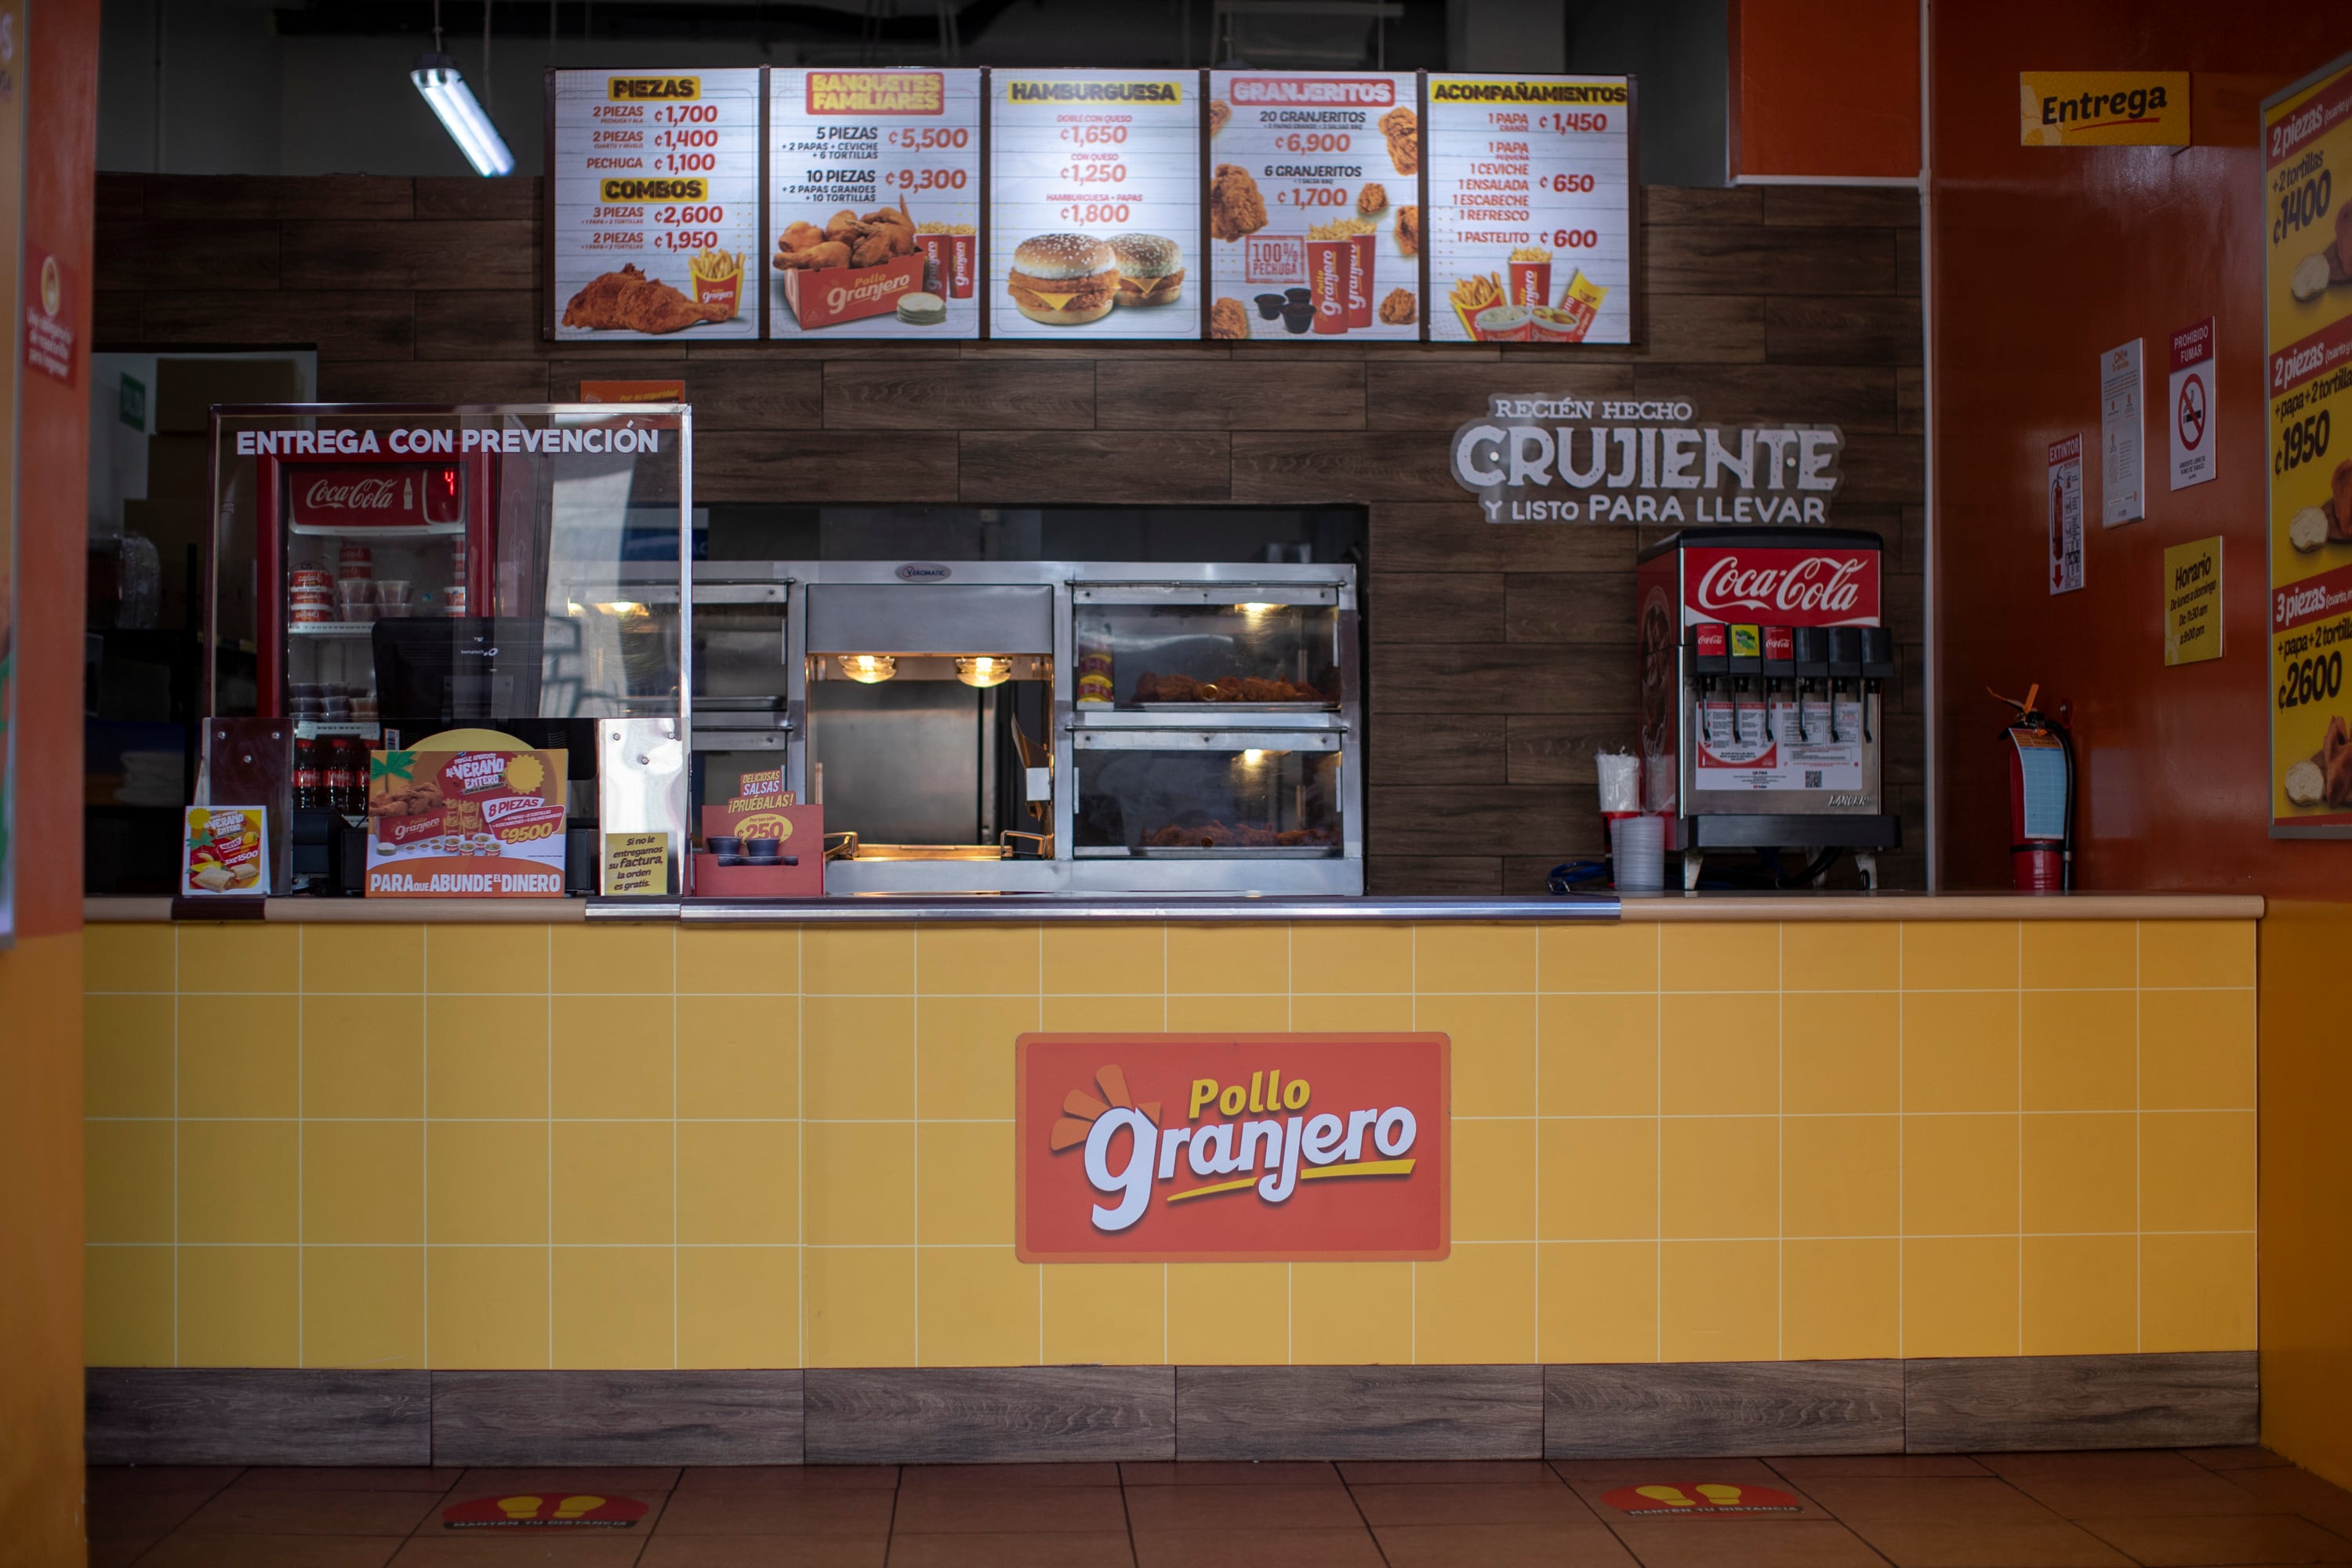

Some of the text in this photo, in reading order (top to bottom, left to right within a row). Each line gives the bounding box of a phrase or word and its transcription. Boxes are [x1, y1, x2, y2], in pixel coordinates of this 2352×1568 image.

[613, 79, 694, 98] PIEZAS
[812, 74, 941, 93] BANQUETES
[1012, 83, 1177, 101] HAMBURGUESA
[1234, 82, 1392, 103] GRANJERITOS
[1436, 82, 1628, 102] ACOMPAÑAMIENTOS
[813, 93, 939, 110] FAMILIARES
[2042, 85, 2167, 125] Entrega
[593, 107, 601, 117] 2
[604, 107, 644, 118] PIEZAS
[1260, 111, 1366, 123] 20 GRANJERITOS
[1496, 114, 1529, 124] PAPA
[593, 132, 601, 143] 2
[604, 132, 644, 143] PIEZAS
[816, 128, 826, 140] 5
[829, 128, 878, 140] PIEZAS
[2272, 103, 2323, 158] 2 piezas
[1496, 143, 1529, 154] PAPA
[586, 158, 643, 169] PECHUGA
[1265, 166, 1361, 177] 6 GRANJERITOS
[1478, 163, 1529, 176] CEVICHE
[2279, 150, 2324, 192] 2 tortillas
[807, 171, 823, 183] 10
[826, 170, 876, 183] PIEZAS
[1466, 179, 1529, 191] ENSALADA
[605, 180, 702, 199] COMBOS
[1461, 194, 1529, 206] ESCABECHE
[593, 207, 601, 218] 3
[604, 207, 644, 218] PIEZAS
[1468, 210, 1529, 221] REFRESCO
[593, 233, 601, 243] 2
[604, 233, 644, 243] PIEZAS
[1465, 232, 1529, 243] PASTELITO
[1253, 243, 1298, 262] 100%
[1254, 263, 1297, 274] PECHUGA
[855, 273, 886, 288] Pollo
[1321, 250, 1342, 316] granjero
[827, 274, 909, 314] granjero
[2175, 325, 2209, 350] PROHIBIDO
[2180, 343, 2203, 364] FUMAR
[2274, 342, 2324, 389] 2 piezas
[1495, 397, 1693, 420] RECIÉN HECHO
[2280, 380, 2318, 423] papa 2
[237, 420, 659, 455] ENTREGA CON PREVENCIÓN
[1457, 425, 1839, 491] CRUJIENTE
[2049, 437, 2079, 462] EXTINTOR
[306, 478, 398, 510] Coca-Cola
[1486, 495, 1825, 524] Y LISTO PARA LLEVAR
[2175, 552, 2211, 591] Horario
[1697, 557, 1869, 612] Coca-Cola
[2170, 580, 2216, 612] De lunes domingo
[2276, 593, 2285, 623] 3
[2286, 586, 2327, 627] piezas
[2284, 626, 2322, 662] papa 2
[453, 758, 505, 781] VERANO
[742, 771, 780, 784] DELICIOSAS
[464, 775, 499, 789] ENTERO
[743, 781, 779, 797] SALSAS
[488, 799, 539, 817] 8 PIEZAS
[728, 790, 795, 814] ¡PRUÉBALAS!
[395, 817, 440, 840] granjero
[501, 822, 552, 844] ¢9500
[613, 847, 663, 858] entregamos
[619, 855, 663, 869] factura,
[370, 874, 561, 892] PARA QUE ABUNDE EL DINERO
[626, 869, 652, 878] orden
[1189, 1069, 1311, 1120] Pollo
[1084, 1105, 1417, 1231] granjero
